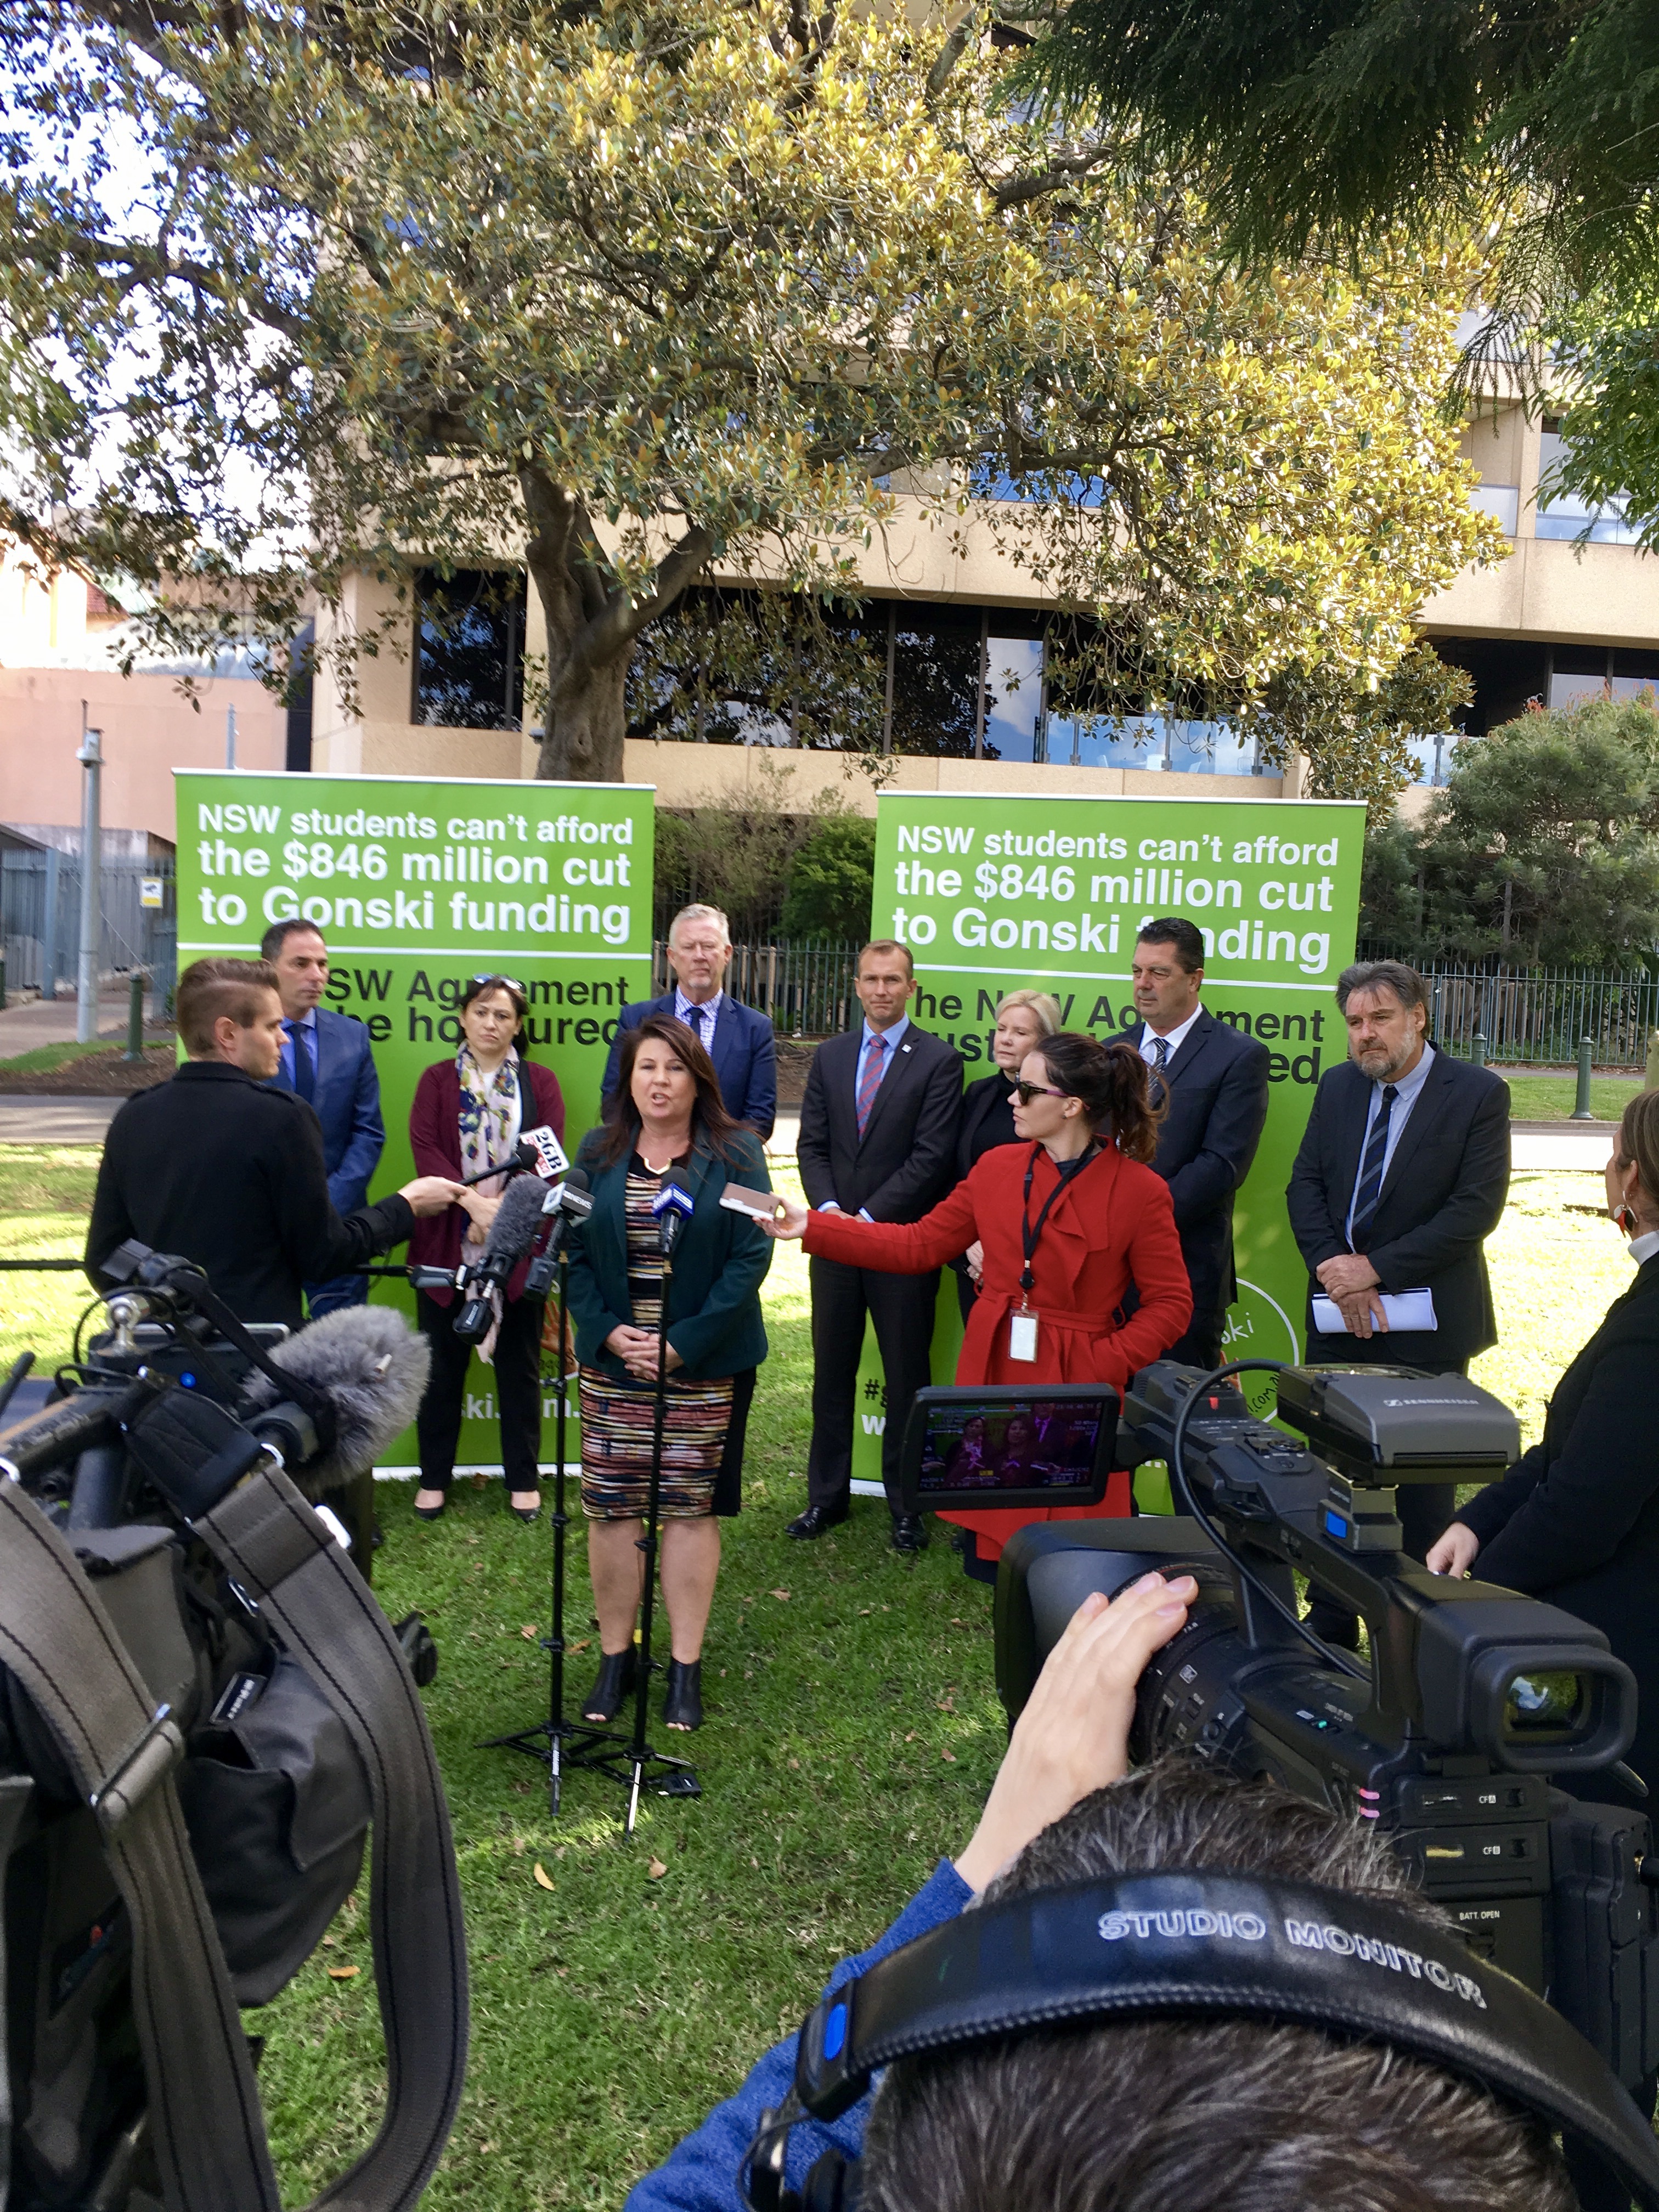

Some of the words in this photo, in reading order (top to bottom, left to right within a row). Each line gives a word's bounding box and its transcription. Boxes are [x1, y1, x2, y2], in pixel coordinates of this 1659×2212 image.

[198, 803, 282, 834] NSW
[289, 808, 438, 839] students
[447, 814, 528, 842] can't
[536, 815, 633, 845] afford
[197, 839, 271, 878] the
[281, 838, 388, 883] $846
[402, 845, 549, 885] million
[562, 853, 631, 888] cut
[897, 825, 975, 855] NSW
[983, 830, 1128, 860] students
[1138, 834, 1223, 863] can't
[1232, 836, 1339, 867] afford
[894, 860, 962, 898] the
[974, 860, 1076, 904] $846
[1090, 867, 1242, 909] million
[1259, 876, 1334, 912] cut
[198, 887, 247, 927] to
[262, 885, 435, 930] Gonski
[448, 891, 631, 945] funding
[891, 907, 937, 946] to
[952, 907, 1120, 953] Gonski
[325, 968, 393, 1002] SW
[915, 985, 962, 1021] he
[535, 1131, 562, 1169] 2GB
[1459, 1912, 1479, 1921] BATT.
[1481, 1910, 1500, 1919] OPEN
[1098, 1909, 1267, 1940] STUDIO
[1284, 1918, 1487, 2010] MONITOR
